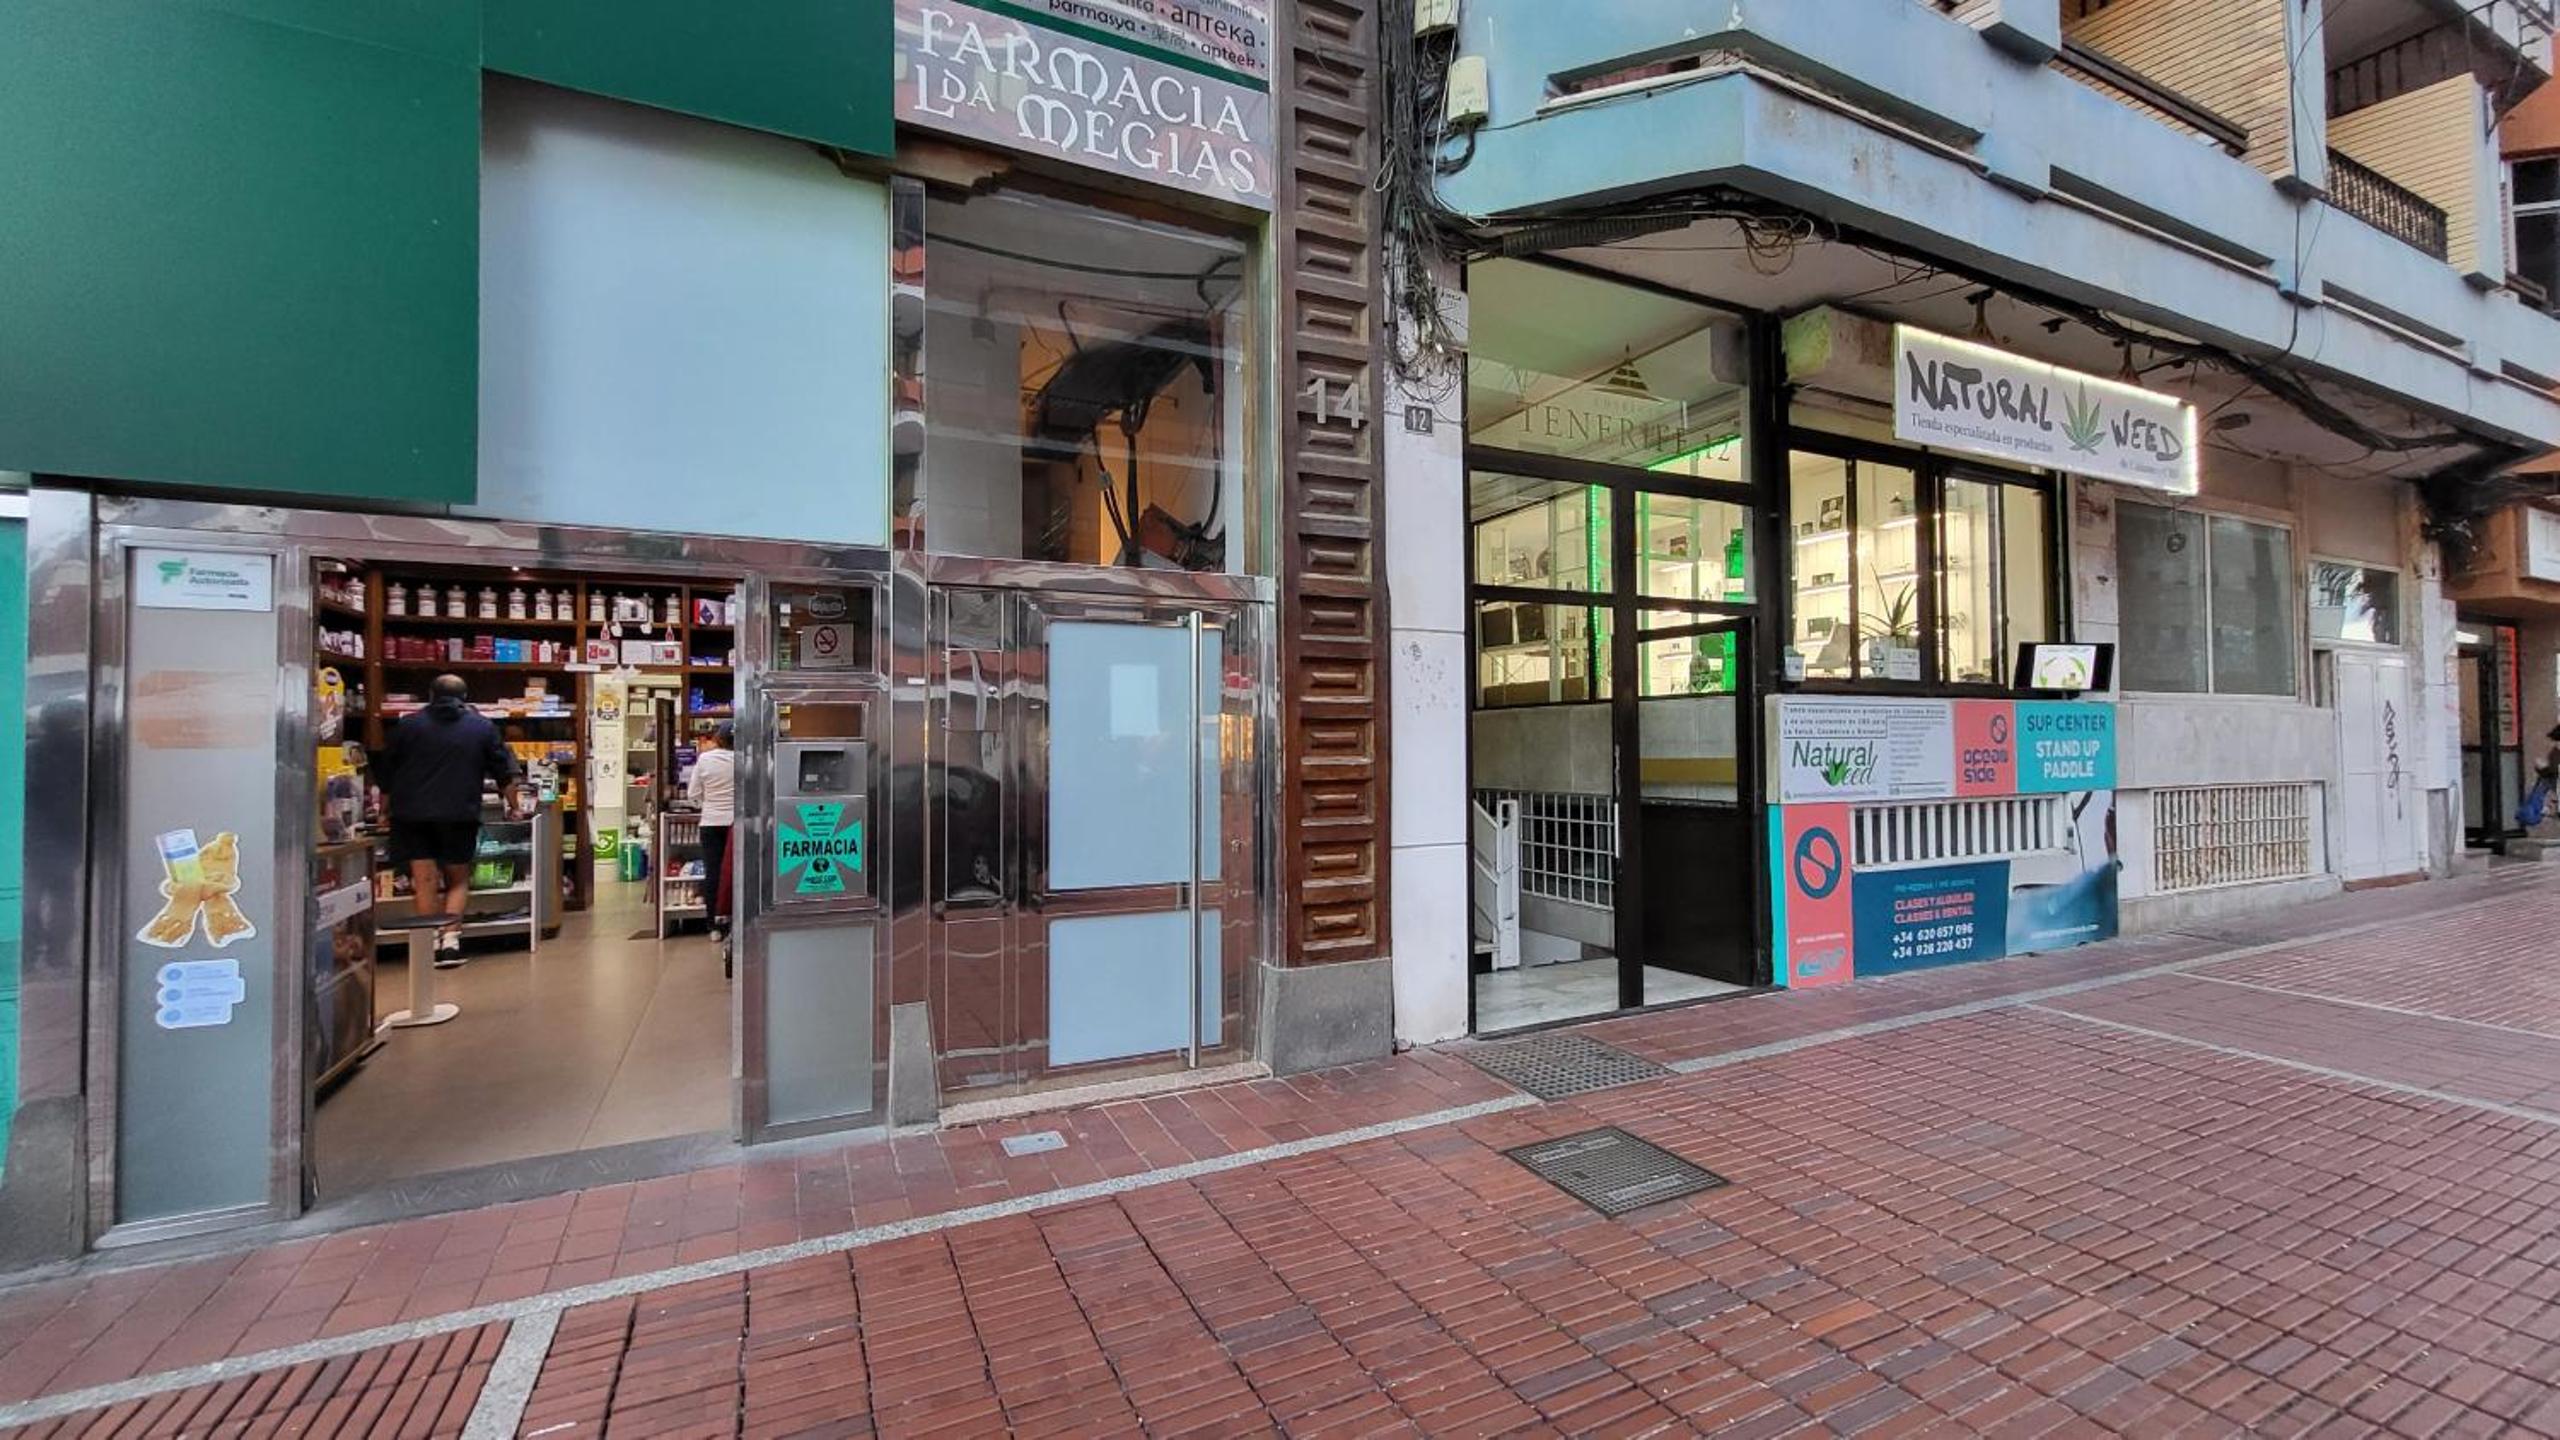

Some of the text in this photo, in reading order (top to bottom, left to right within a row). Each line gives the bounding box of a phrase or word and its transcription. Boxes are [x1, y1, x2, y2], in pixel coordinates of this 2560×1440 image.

[1048, 0, 1136, 32] parmasya
[917, 7, 1251, 143] FARMACIA
[1016, 93, 1257, 194] MEGIAS
[1306, 378, 1365, 429] 14
[1906, 350, 2184, 462] NATURAL WEED
[1411, 408, 1428, 431] 12
[2026, 714, 2106, 732] SUP CENTER
[1792, 740, 1874, 768] Natural
[2036, 740, 2100, 758] STAND UP
[2044, 760, 2094, 779] PADDLE
[783, 838, 858, 858] FARMACIA
[1892, 931, 1913, 944] +34
[1892, 945, 1912, 959] +34
